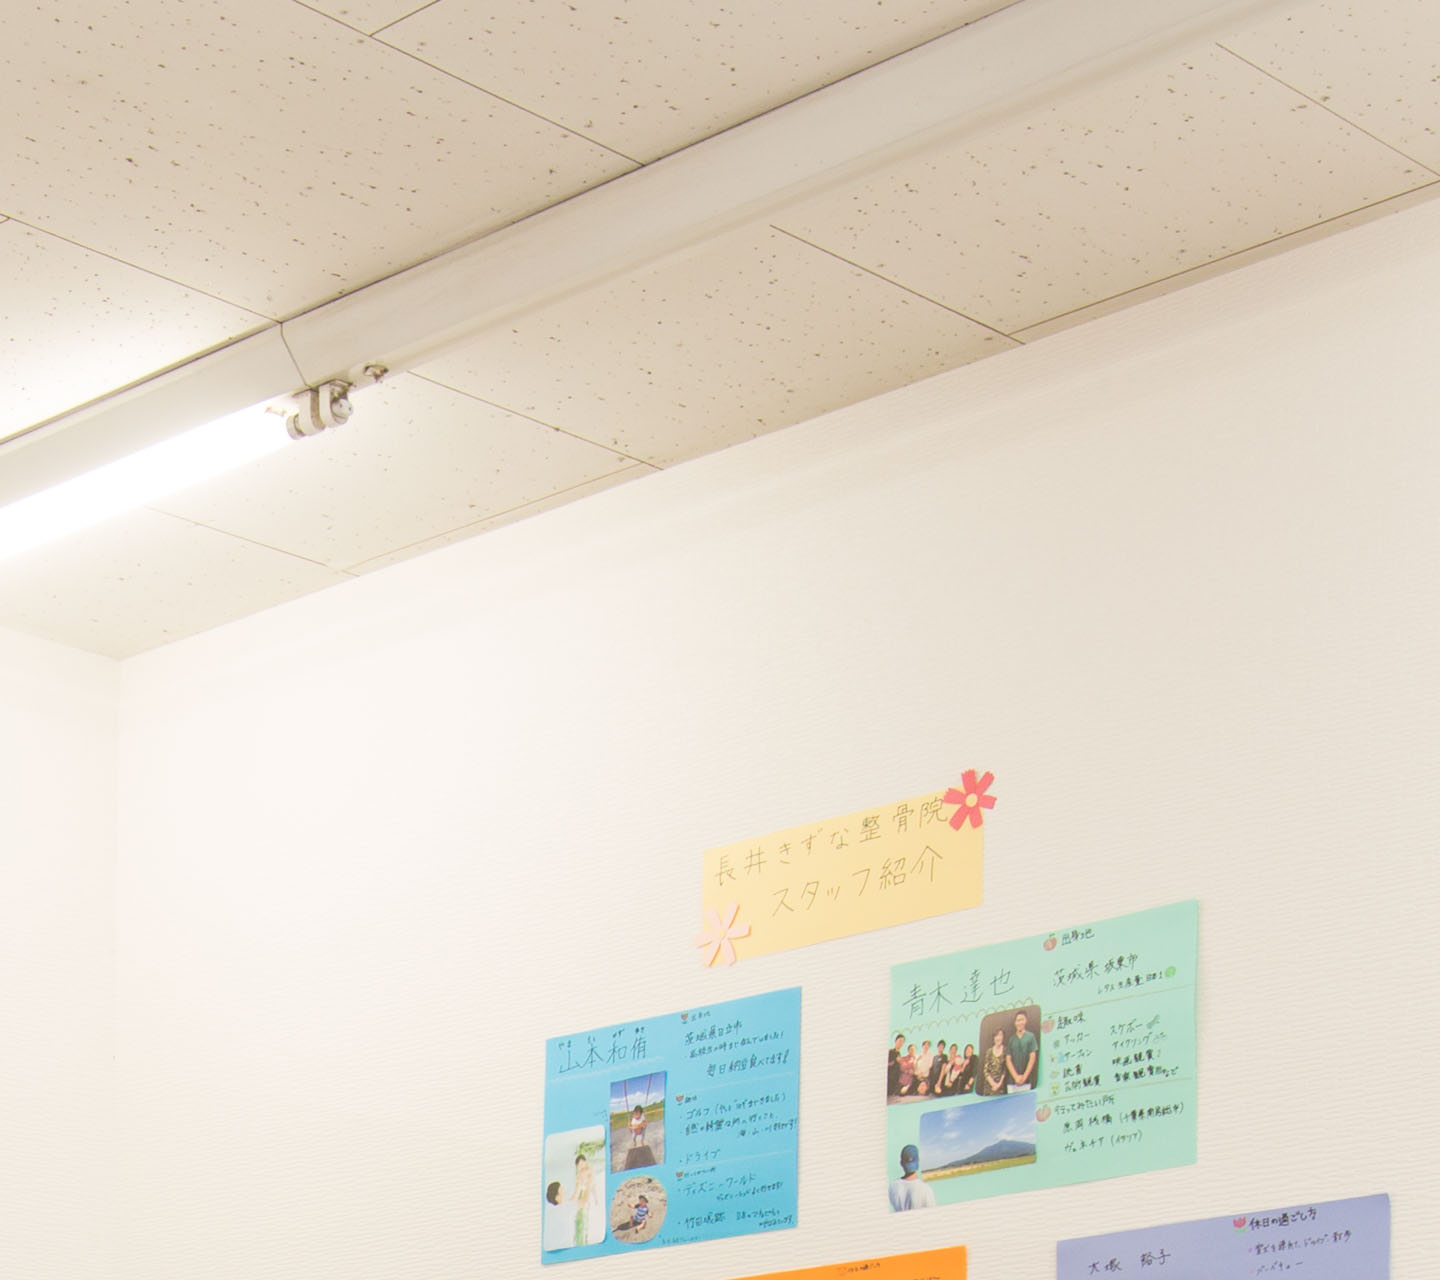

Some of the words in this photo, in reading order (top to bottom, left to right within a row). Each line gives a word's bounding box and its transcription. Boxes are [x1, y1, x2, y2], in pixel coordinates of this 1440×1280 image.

[714, 797, 948, 887] 長井きずな整骨院
[772, 845, 943, 916] スタッフ紹介
[903, 968, 1014, 1019] 青木達也
[1056, 1011, 1086, 1030] 趣味
[686, 1107, 711, 1120] ゴルフ
[1054, 1095, 1115, 1116] 行ってみたい所
[686, 1149, 721, 1164] ドライブ
[1249, 1205, 1318, 1231] 休日の過ごし方
[1088, 1257, 1123, 1276] 大塚
